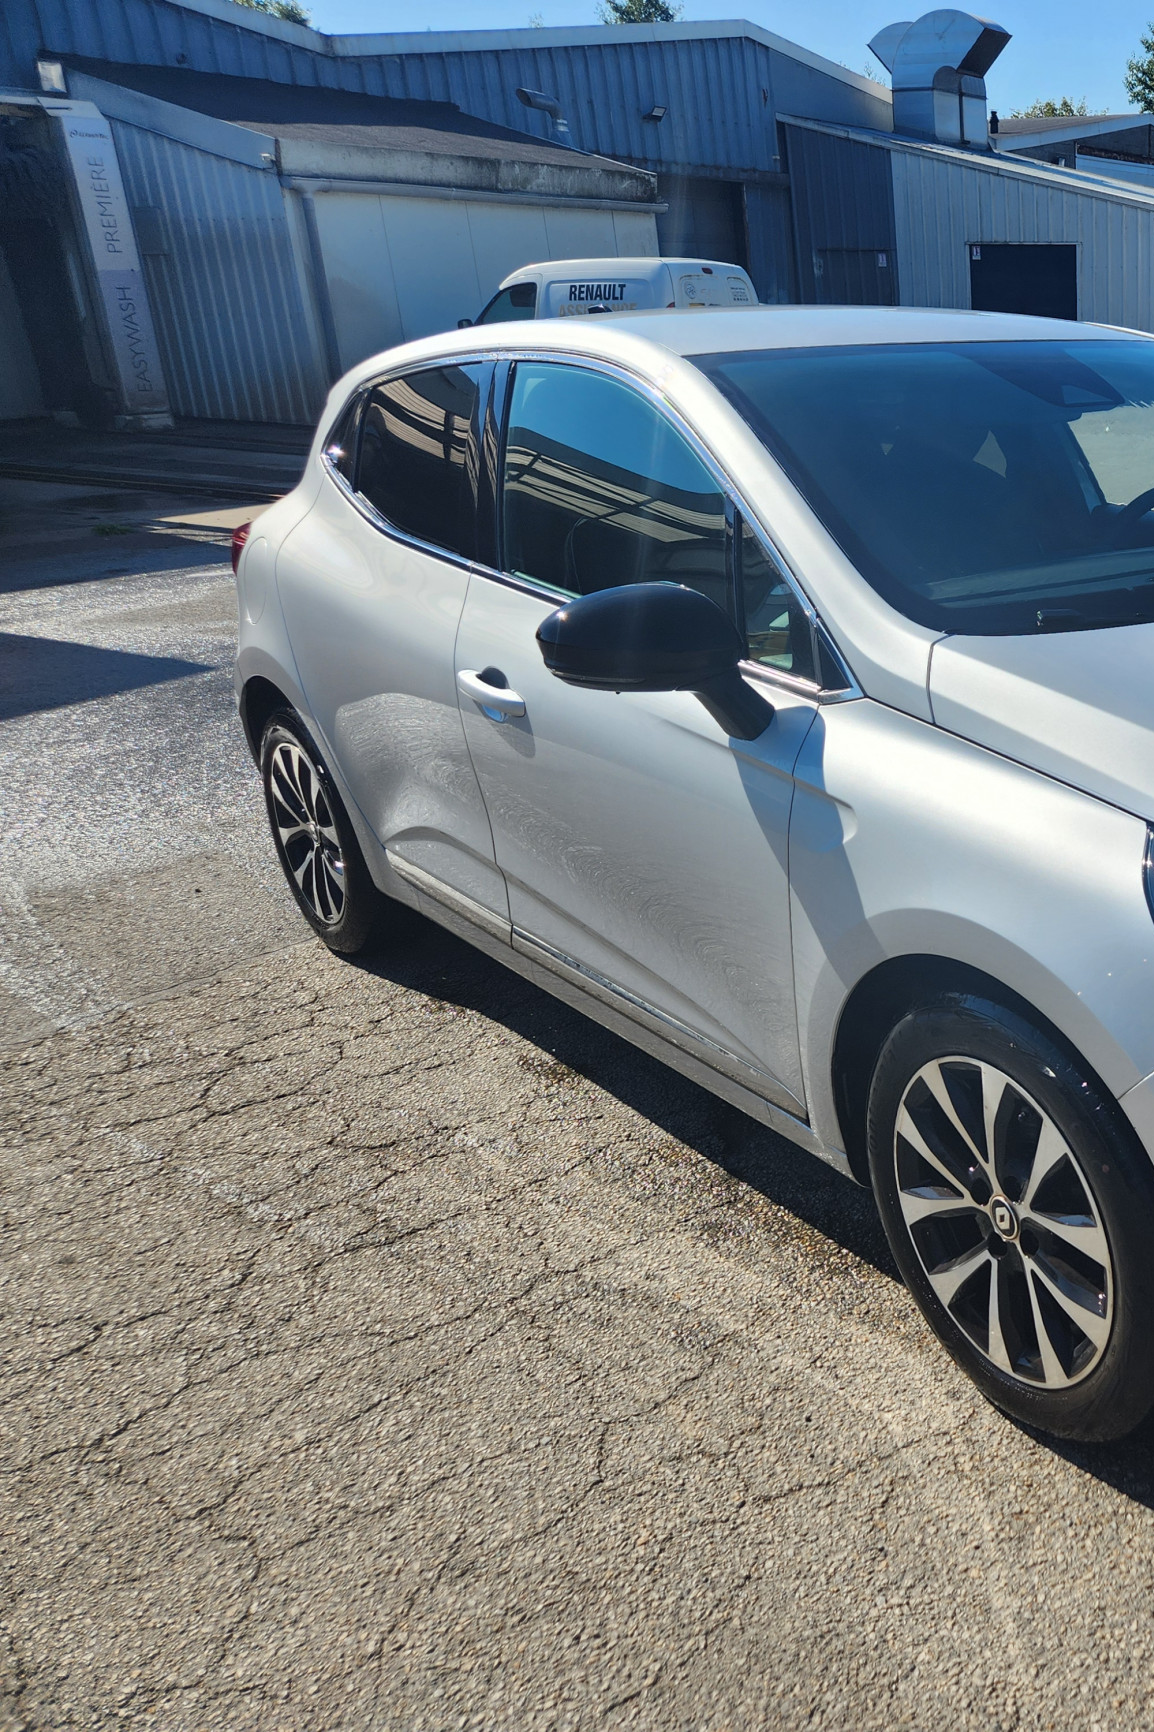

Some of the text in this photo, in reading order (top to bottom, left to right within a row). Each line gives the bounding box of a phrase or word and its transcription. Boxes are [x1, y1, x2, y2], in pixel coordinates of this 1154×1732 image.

[88, 156, 124, 254] PREMIÈRE
[115, 286, 152, 393] EASYWASH
[568, 284, 626, 302] RENAULT
